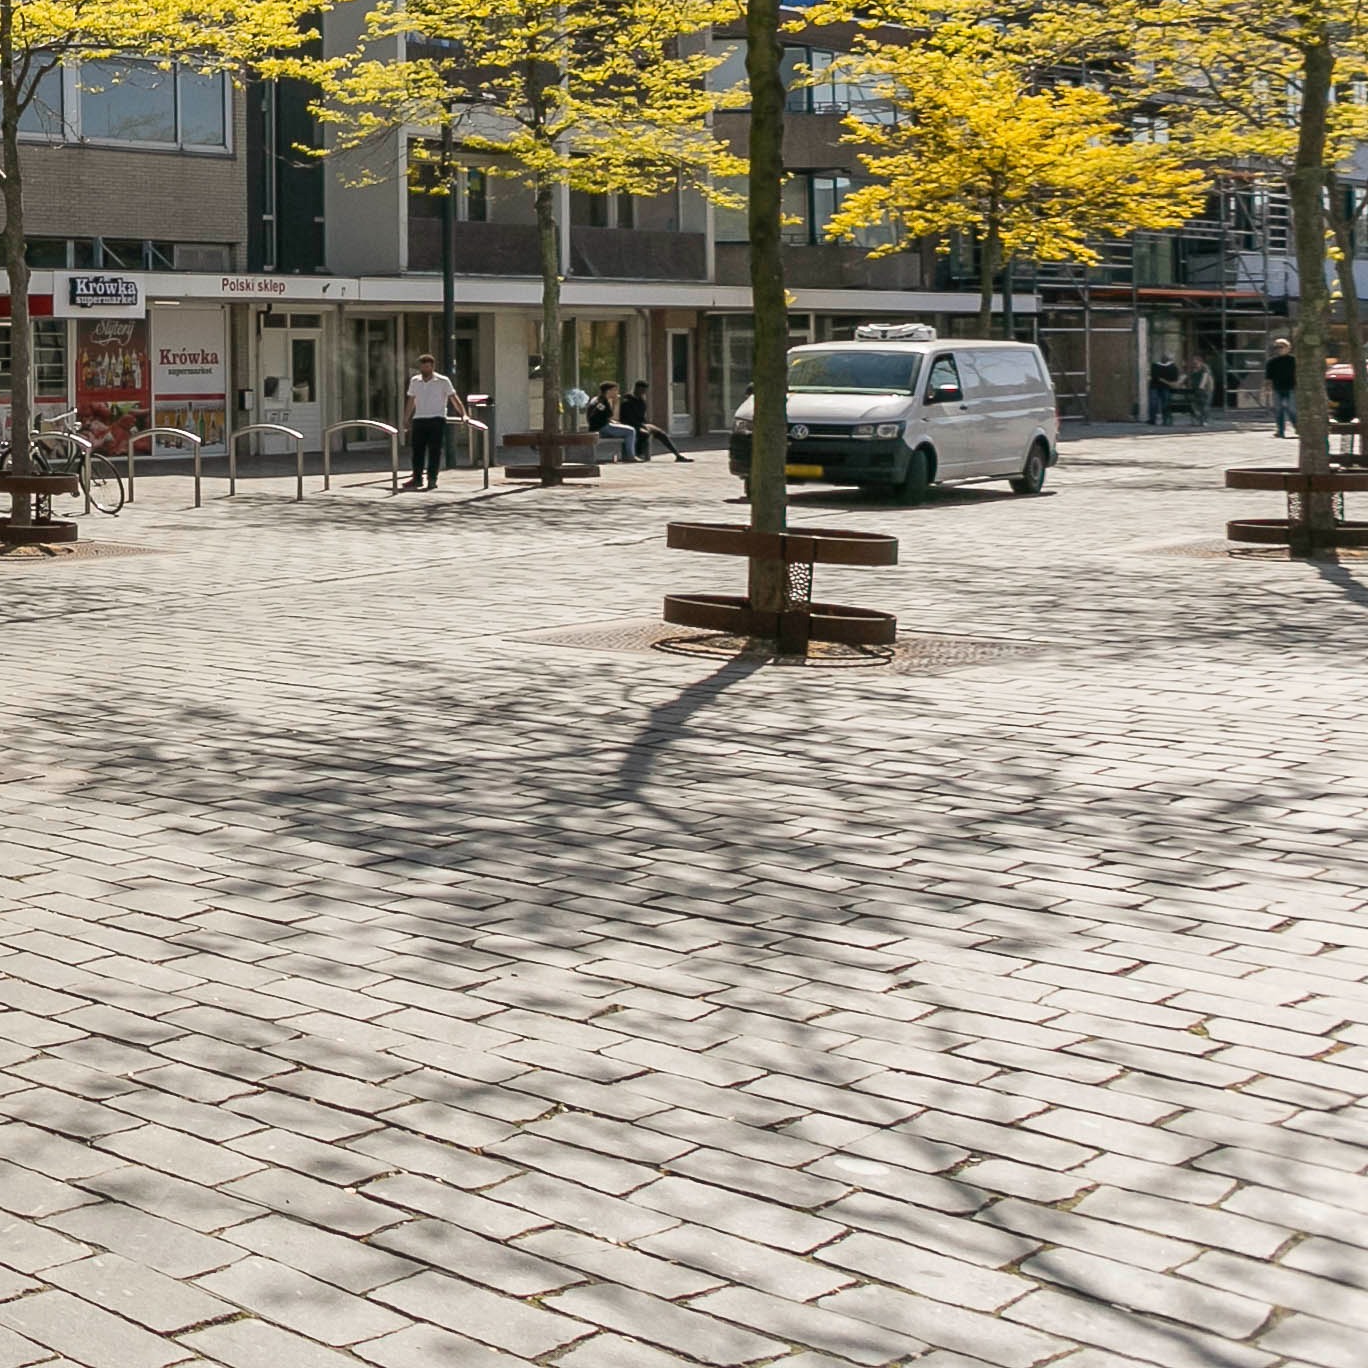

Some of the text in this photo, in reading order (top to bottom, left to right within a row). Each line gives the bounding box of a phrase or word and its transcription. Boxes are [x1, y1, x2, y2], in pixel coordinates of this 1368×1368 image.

[75, 277, 137, 295] Krówka
[221, 278, 286, 295] Polski sklep
[75, 295, 137, 305] supermarket
[159, 347, 219, 365] Krówka
[168, 368, 213, 376] supermarket
